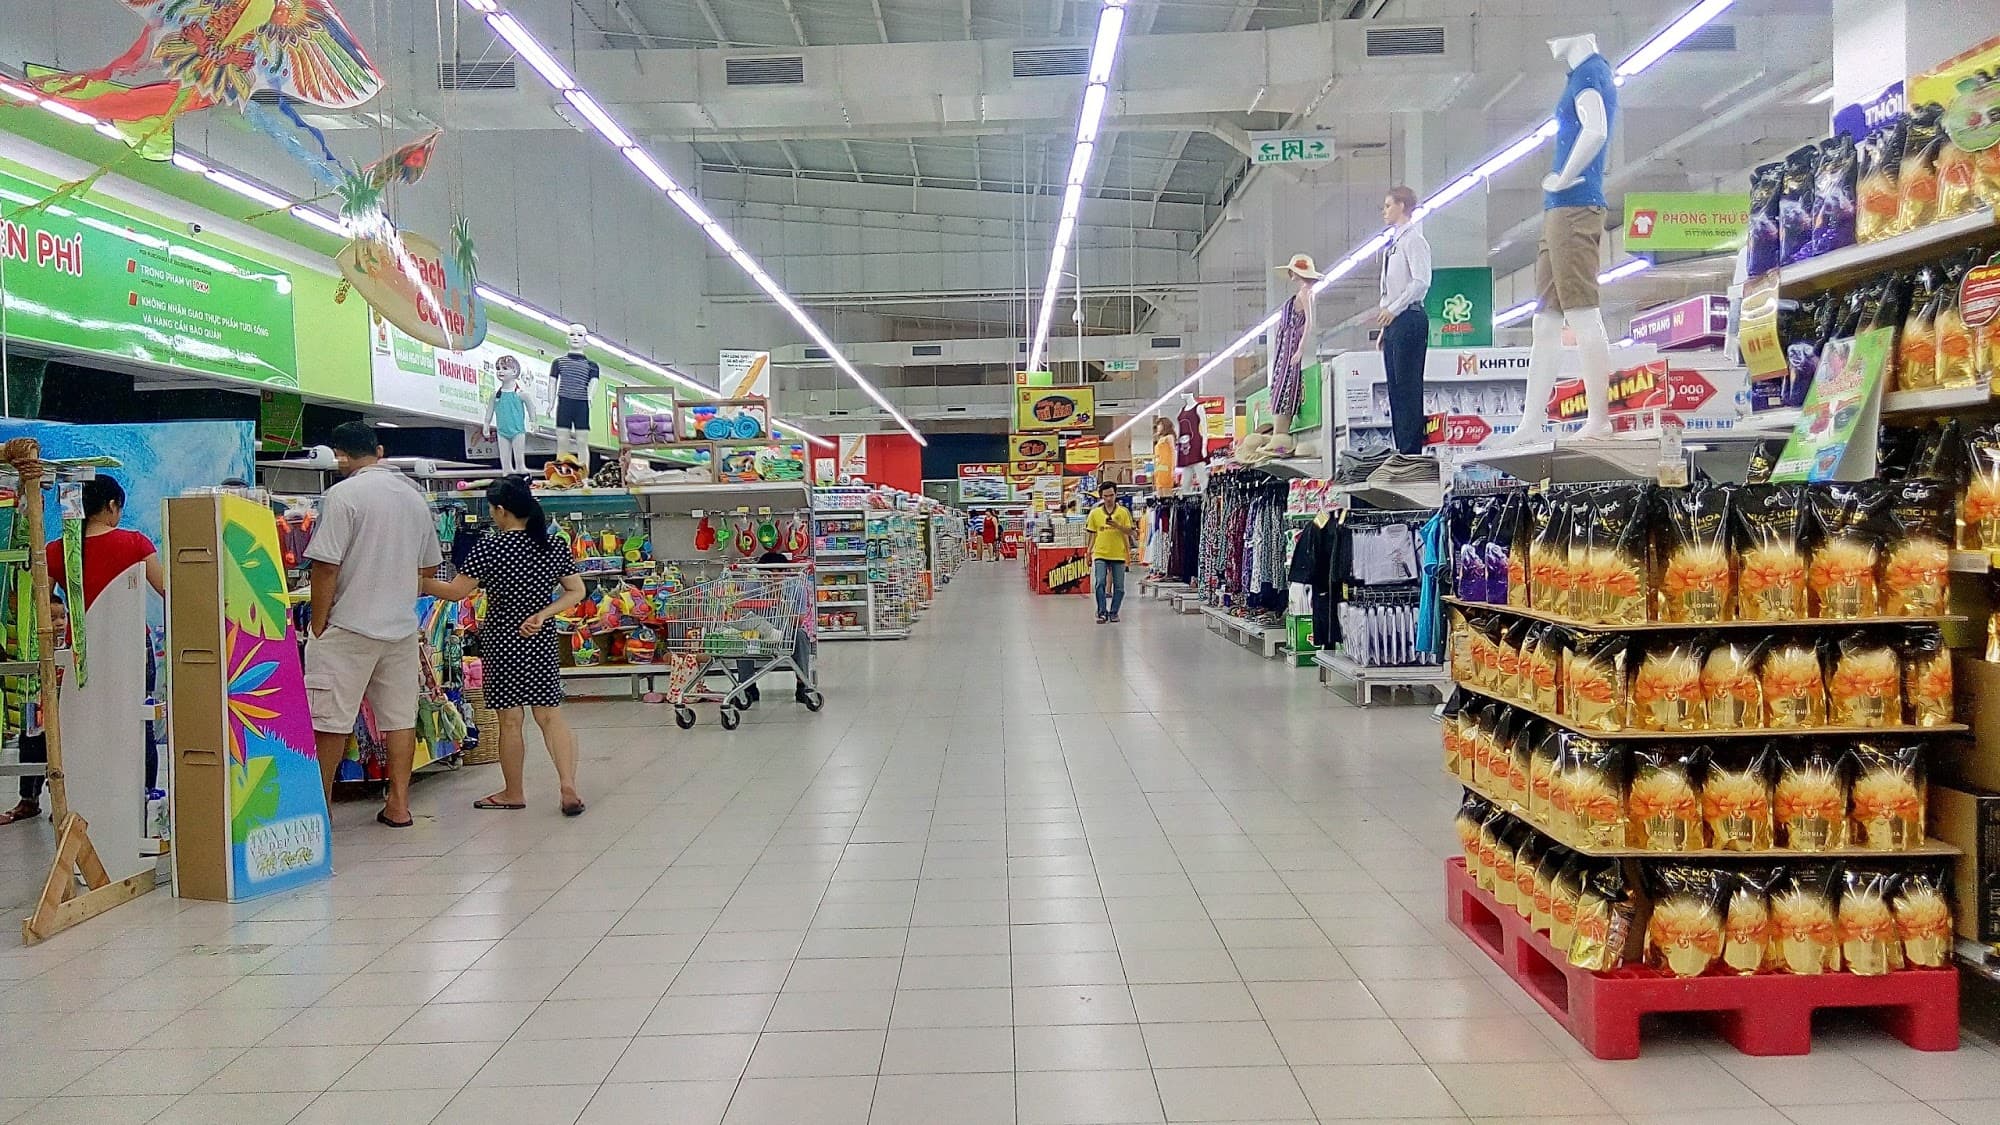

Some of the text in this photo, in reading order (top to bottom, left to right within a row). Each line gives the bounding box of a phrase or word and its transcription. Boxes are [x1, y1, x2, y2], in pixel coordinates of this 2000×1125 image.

[1258, 154, 1280, 162] EXIT
[37, 231, 82, 278] PHÍ
[141, 264, 165, 280] TRONG
[141, 296, 166, 312] KHÔNG
[1648, 317, 1671, 336] TRANG
[963, 464, 985, 474] GIÁ
[1004, 533, 1018, 543] GIÁ
